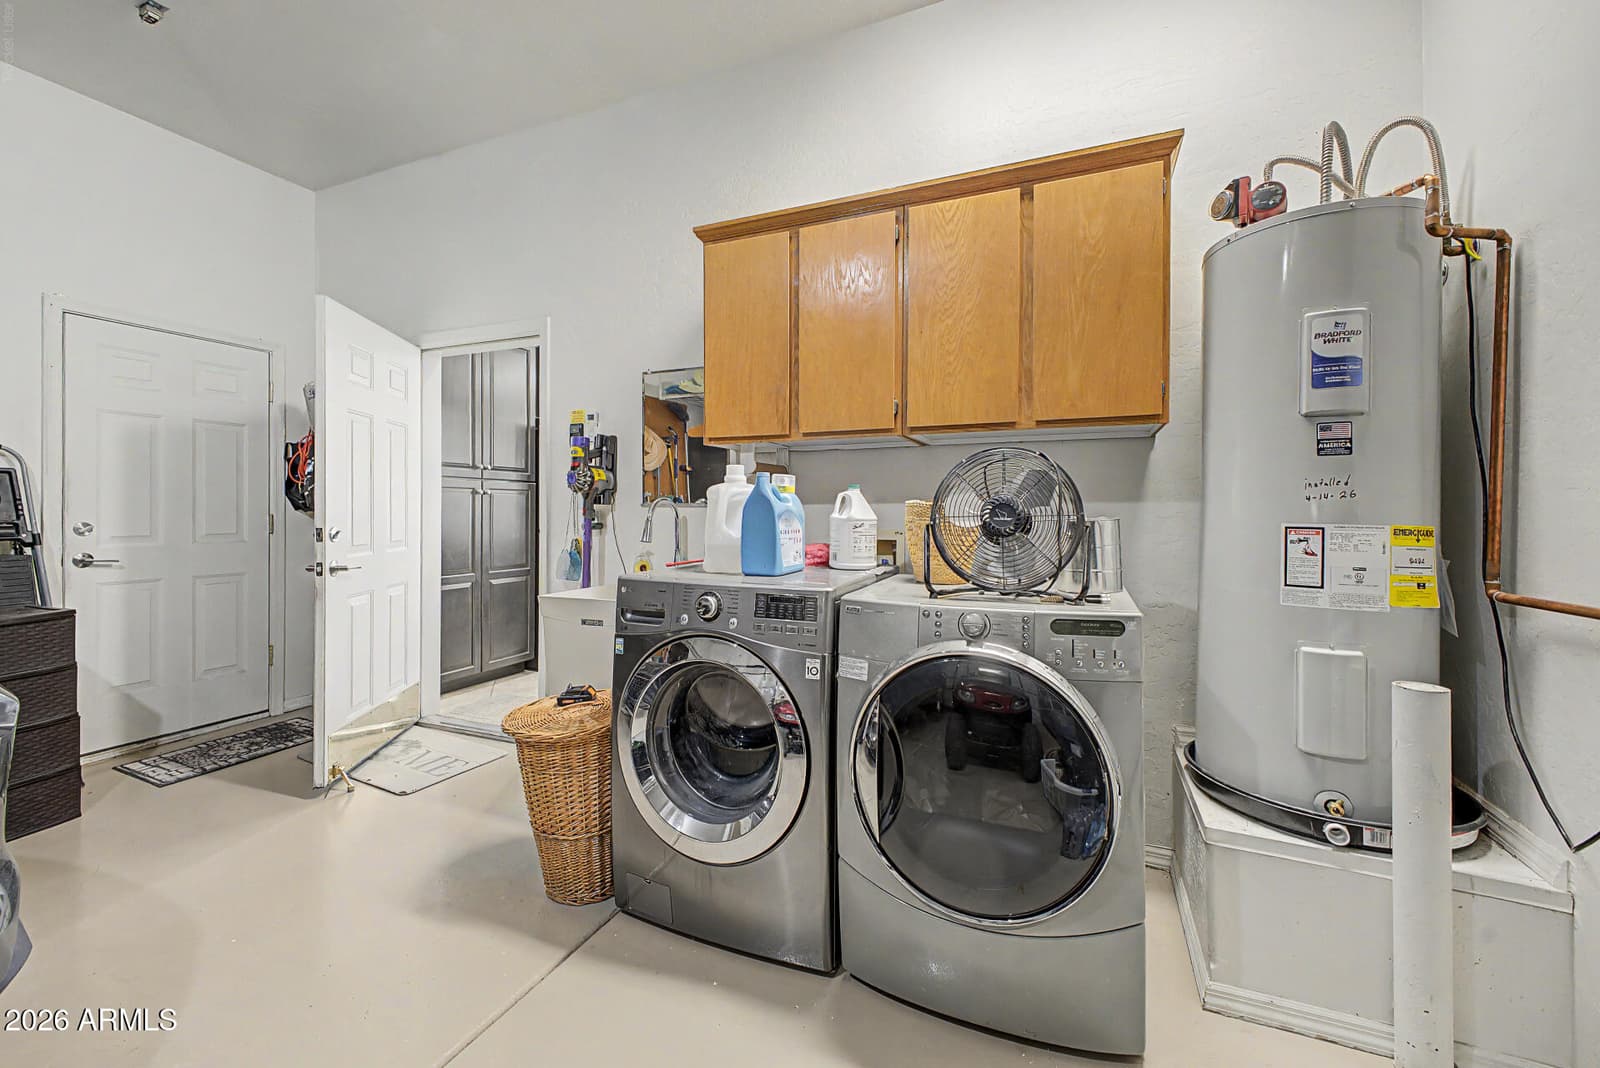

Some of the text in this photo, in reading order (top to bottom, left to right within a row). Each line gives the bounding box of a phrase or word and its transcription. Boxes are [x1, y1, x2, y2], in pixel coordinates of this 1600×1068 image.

[1314, 329, 1362, 340] BRADFORD
[1323, 336, 1353, 344] WHITE
[1304, 473, 1351, 491] installed
